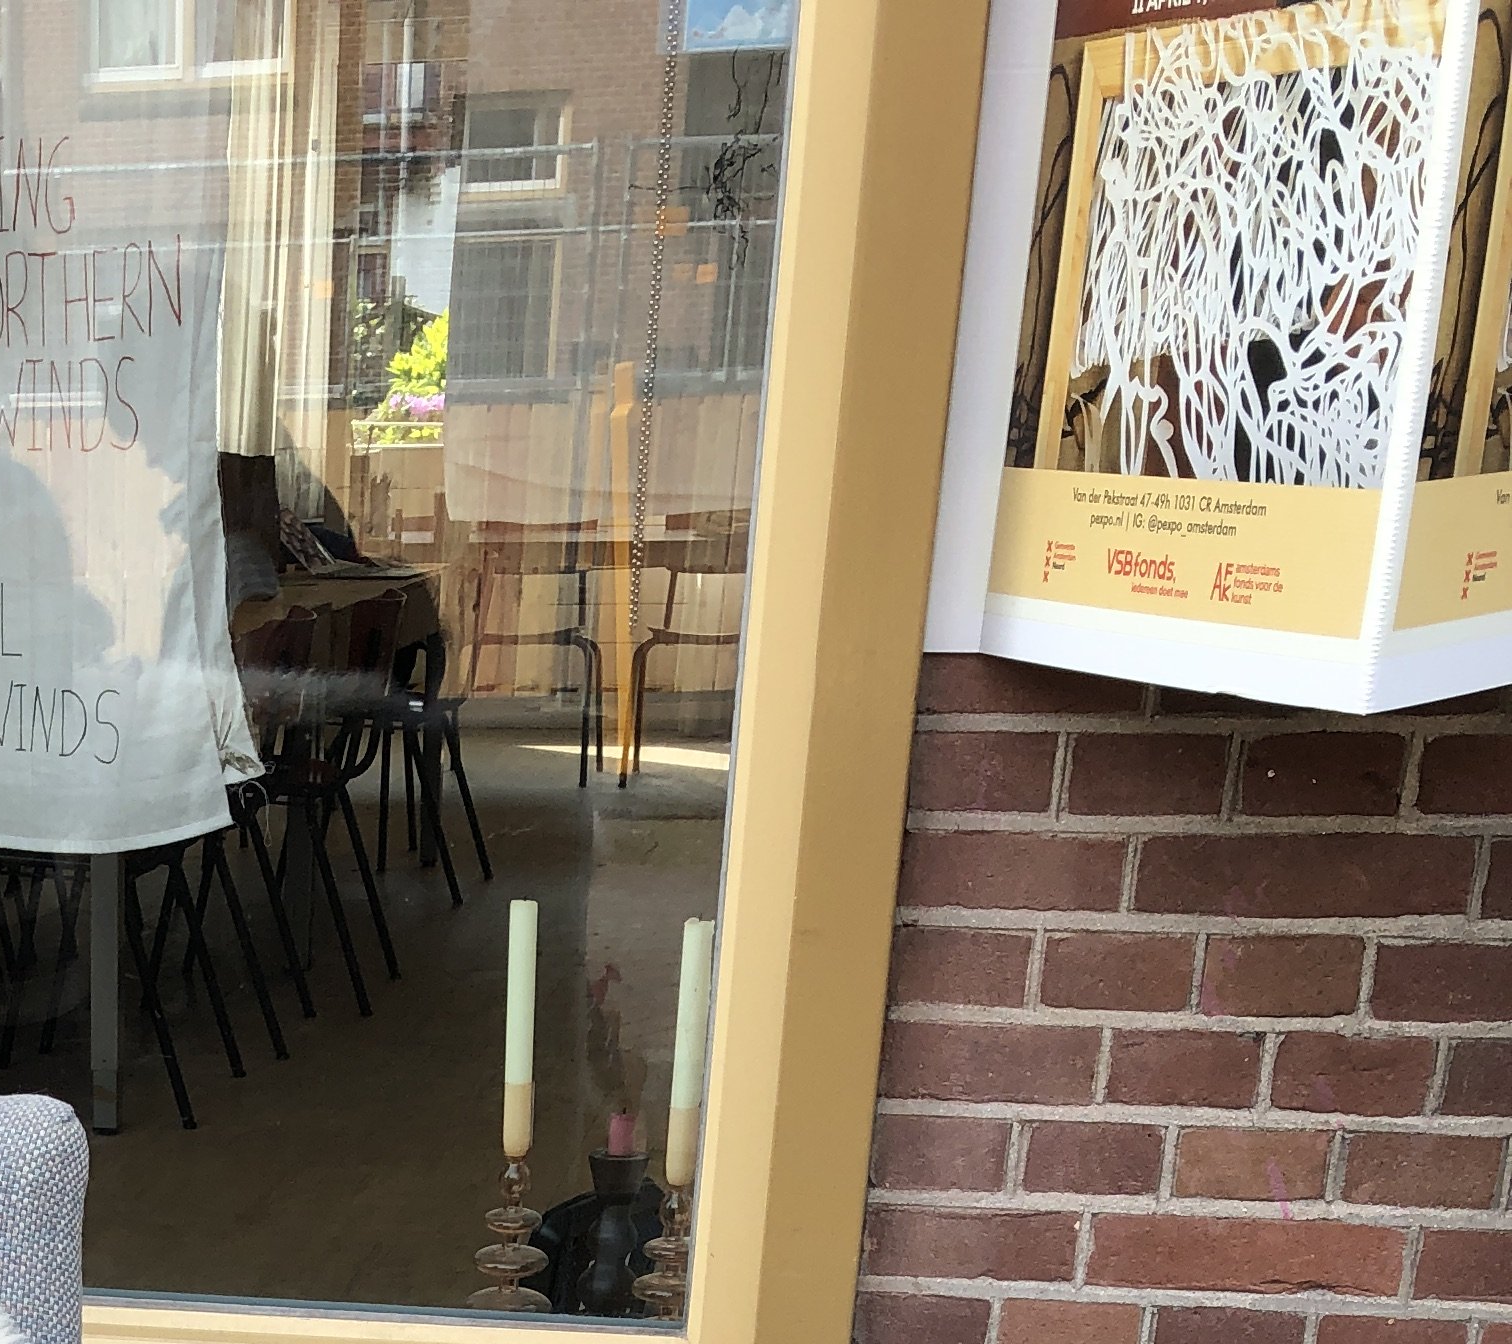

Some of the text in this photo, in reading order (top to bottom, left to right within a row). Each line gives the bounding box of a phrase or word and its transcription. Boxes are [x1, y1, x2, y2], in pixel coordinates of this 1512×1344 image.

[1073, 488, 1086, 502] Van
[1089, 489, 1101, 503] der
[1140, 493, 1170, 509] 47-49h
[1174, 494, 1195, 510] 1031
[1199, 496, 1212, 513] CR
[1214, 497, 1266, 516] Amsterdam
[1090, 512, 1123, 527] pexpo.nl
[1133, 514, 1145, 529] IG:
[1148, 515, 1236, 537] @pexpo_amsterdam
